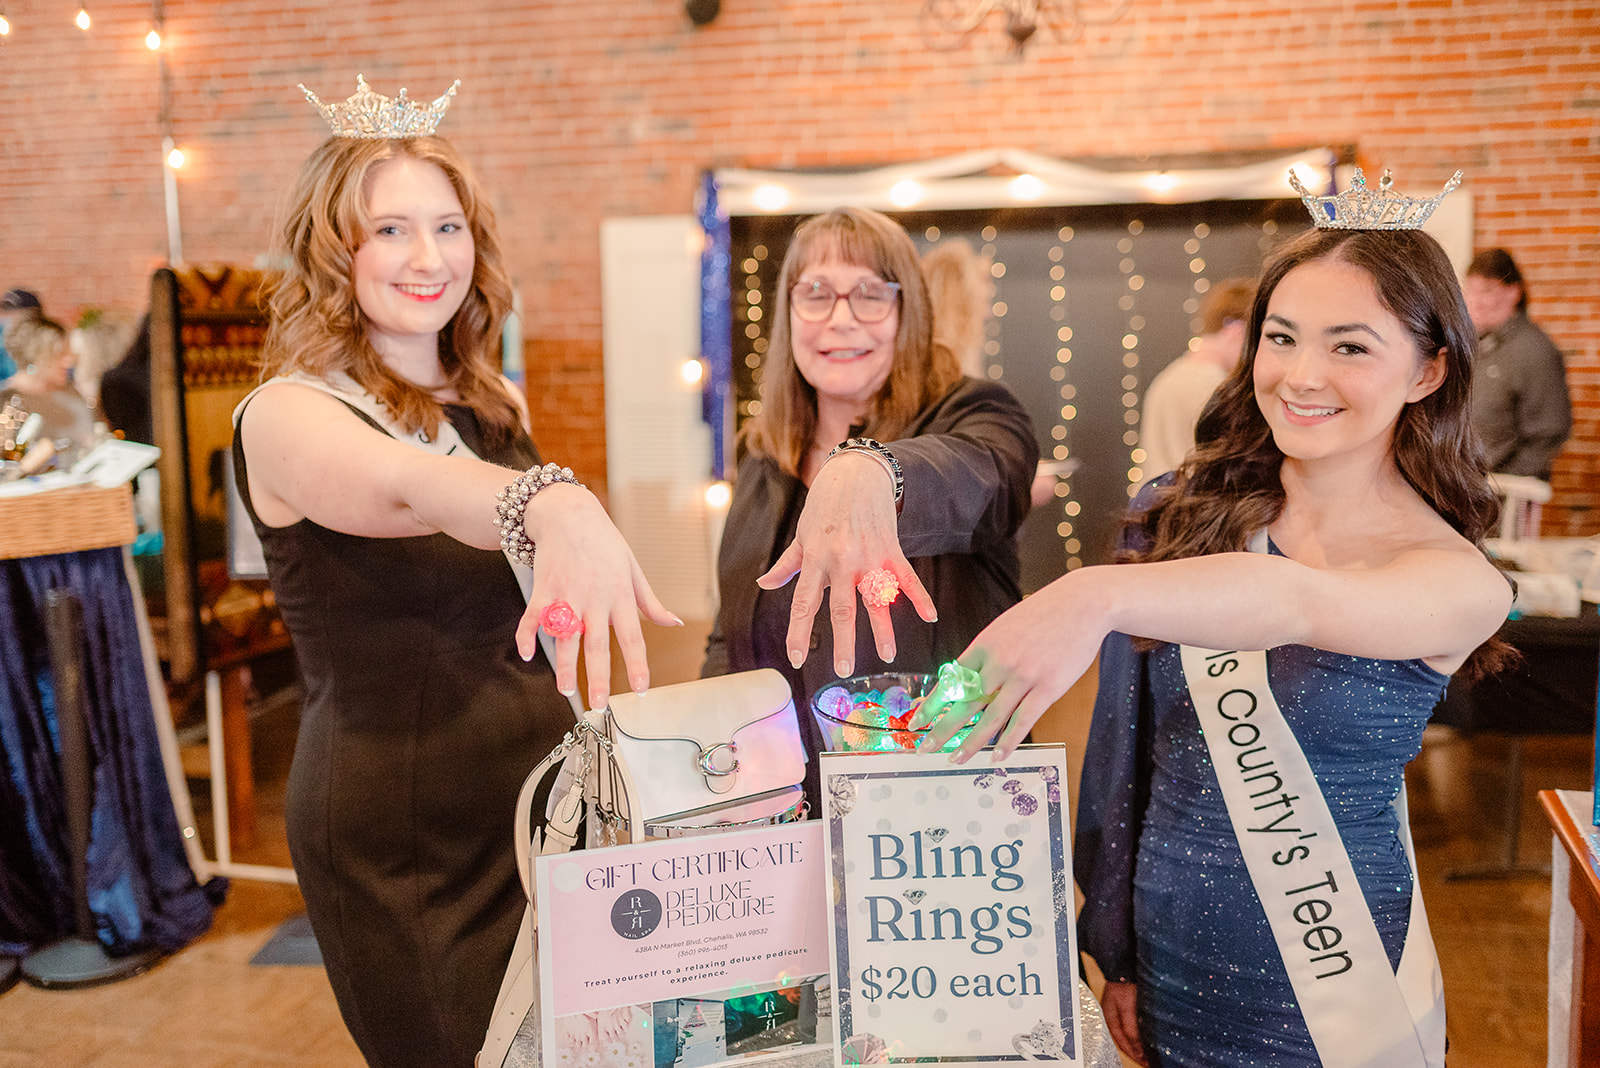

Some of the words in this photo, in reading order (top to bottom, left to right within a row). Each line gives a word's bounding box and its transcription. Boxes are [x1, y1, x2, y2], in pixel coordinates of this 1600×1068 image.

[1217, 689, 1318, 866] County's
[1284, 870, 1353, 980] Teen
[586, 862, 643, 891] GIFT
[652, 841, 804, 882] CERTIFICATE
[867, 829, 1024, 892] Bling
[666, 880, 752, 910] DELUXE
[666, 896, 775, 929] PEDICURE
[641, 928, 652, 936] SPA
[660, 941, 684, 950] Market
[748, 928, 769, 936] 98532
[864, 893, 1033, 954] Rings
[584, 978, 611, 988] Treat
[616, 970, 658, 985] yourself
[685, 960, 726, 972] relaxing
[730, 954, 762, 964] deluxe
[766, 947, 809, 960] pedicure
[678, 948, 696, 958] (360)
[698, 944, 728, 954] 996-4013
[670, 970, 728, 984] experience.
[860, 964, 938, 1003] $20
[949, 962, 1044, 998] each
